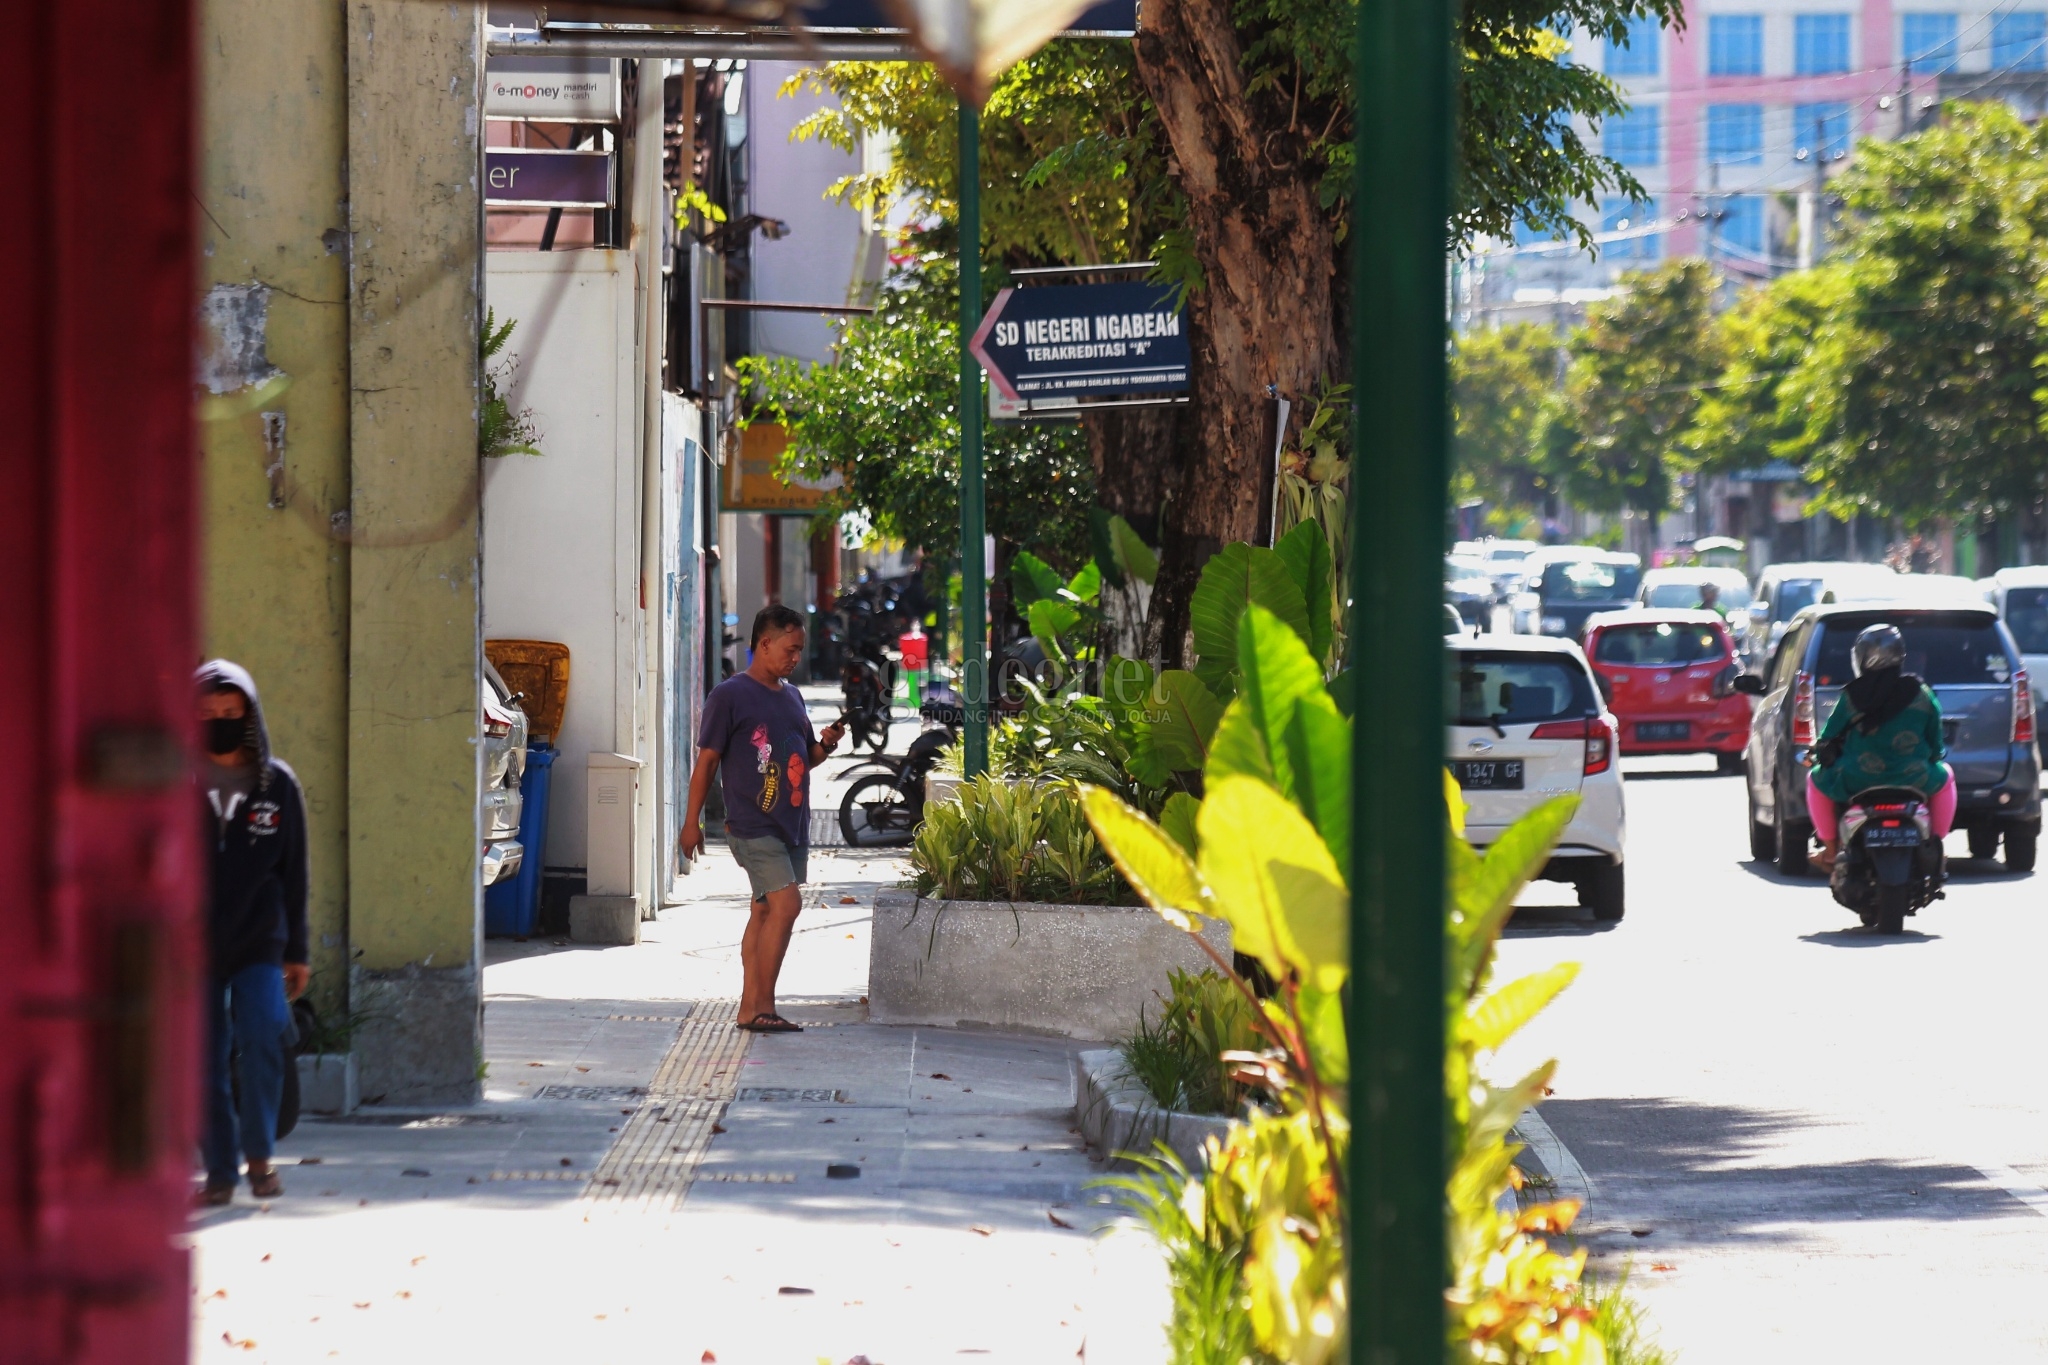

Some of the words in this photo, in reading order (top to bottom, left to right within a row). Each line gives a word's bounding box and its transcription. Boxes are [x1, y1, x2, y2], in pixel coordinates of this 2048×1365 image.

[497, 85, 560, 100] e-money
[564, 83, 597, 91] mandiri
[564, 92, 590, 100] e-cash
[996, 321, 1019, 347] SD
[1025, 316, 1090, 345] NEGERI
[1096, 312, 1180, 341] NGABEAN
[1026, 343, 1127, 362] TERAKREDITASI
[1017, 382, 1041, 392] ALAMAT
[1066, 379, 1087, 388] AHMAD
[1088, 377, 1112, 387] DAHLAN
[1130, 373, 1167, 384] YOGYAKARTA
[1465, 763, 1496, 778] 1347
[1505, 763, 1520, 778] GF
